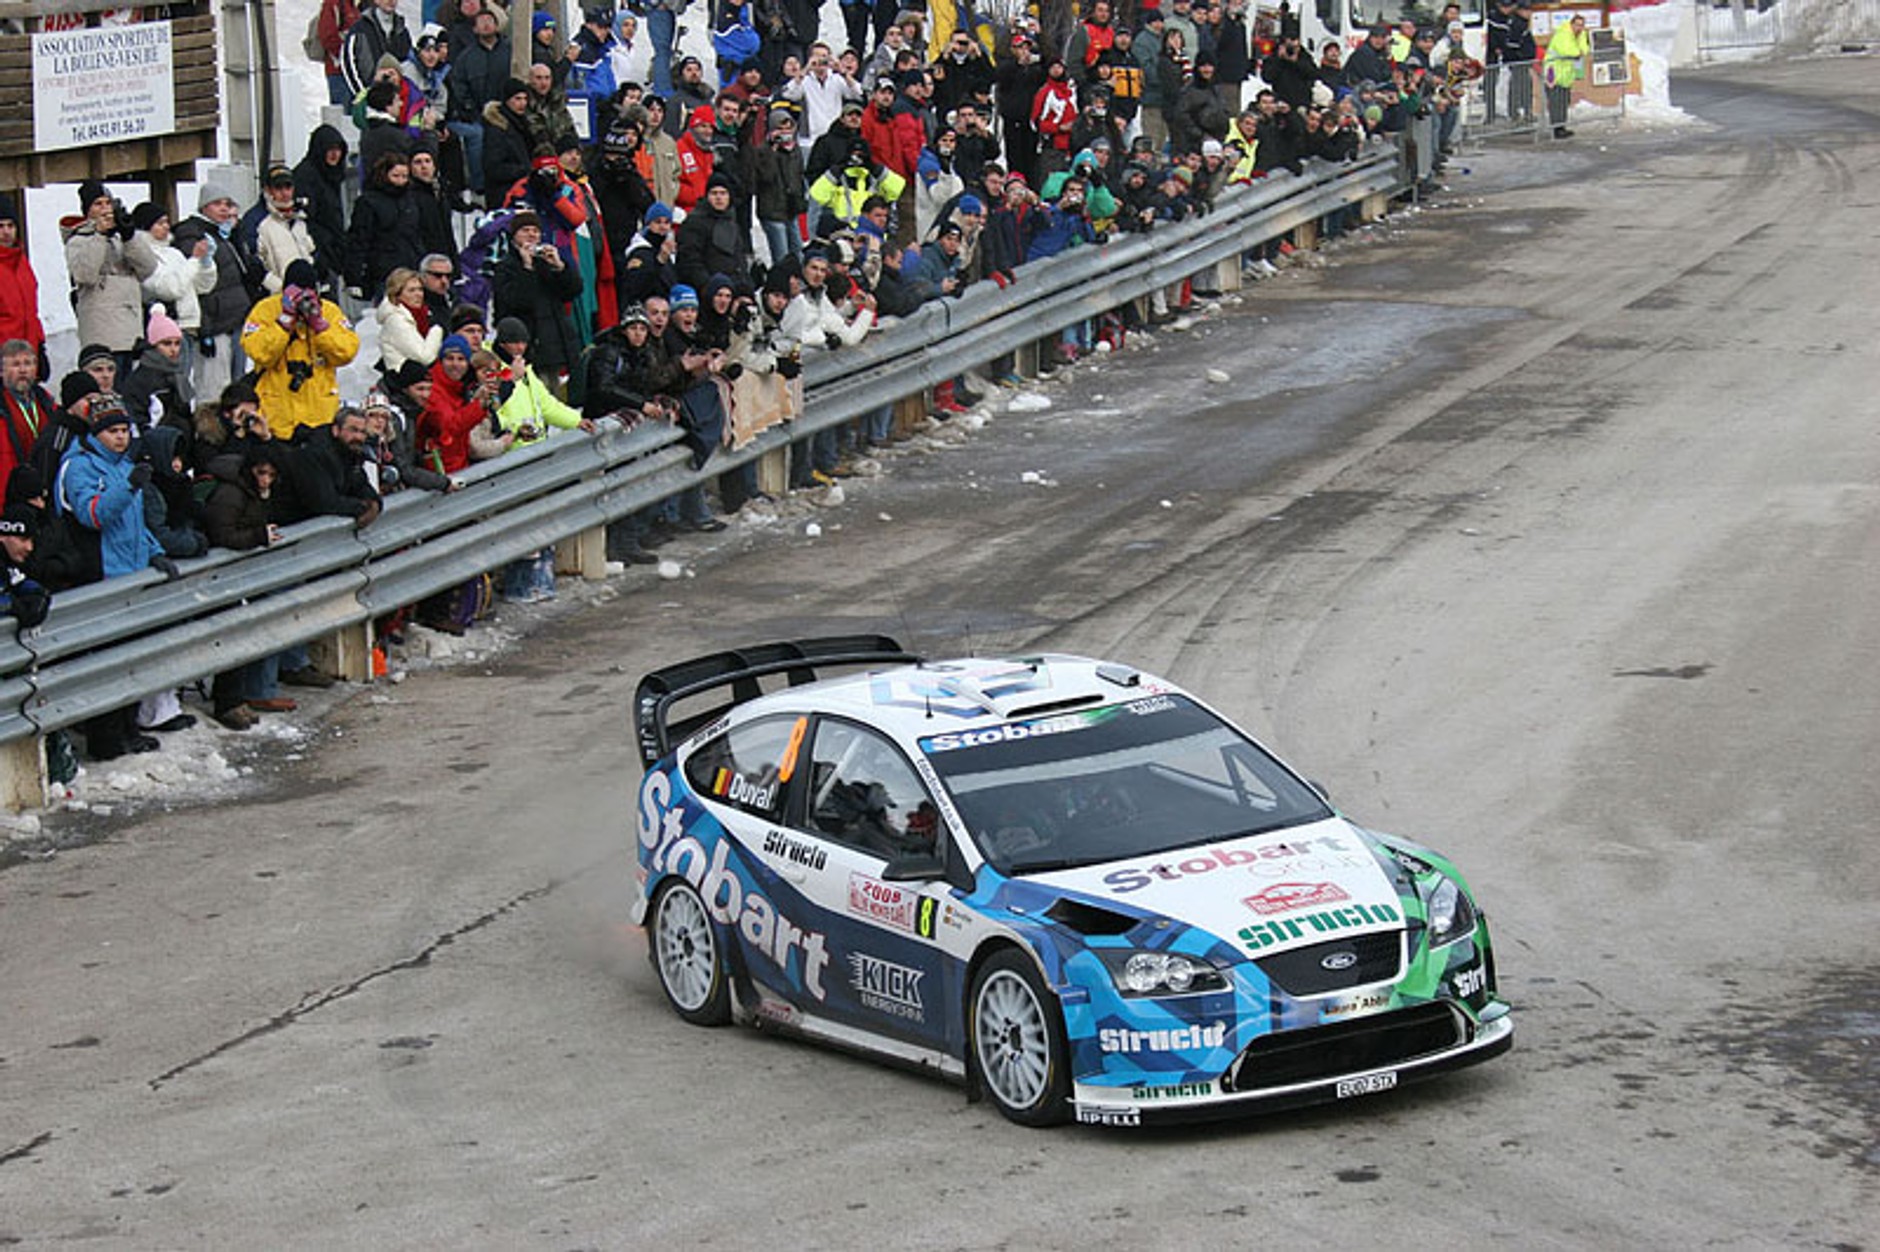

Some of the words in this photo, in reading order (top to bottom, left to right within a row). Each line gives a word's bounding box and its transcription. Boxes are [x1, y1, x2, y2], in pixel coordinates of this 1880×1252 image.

[728, 772, 775, 810] Duval
[763, 830, 828, 870] Structo
[1103, 836, 1345, 894] Stobart
[638, 770, 829, 1001] Stobart
[919, 896, 933, 937] 8
[1237, 903, 1400, 950] Structo
[860, 957, 923, 1006] KICK
[1100, 1024, 1224, 1052] Structo
